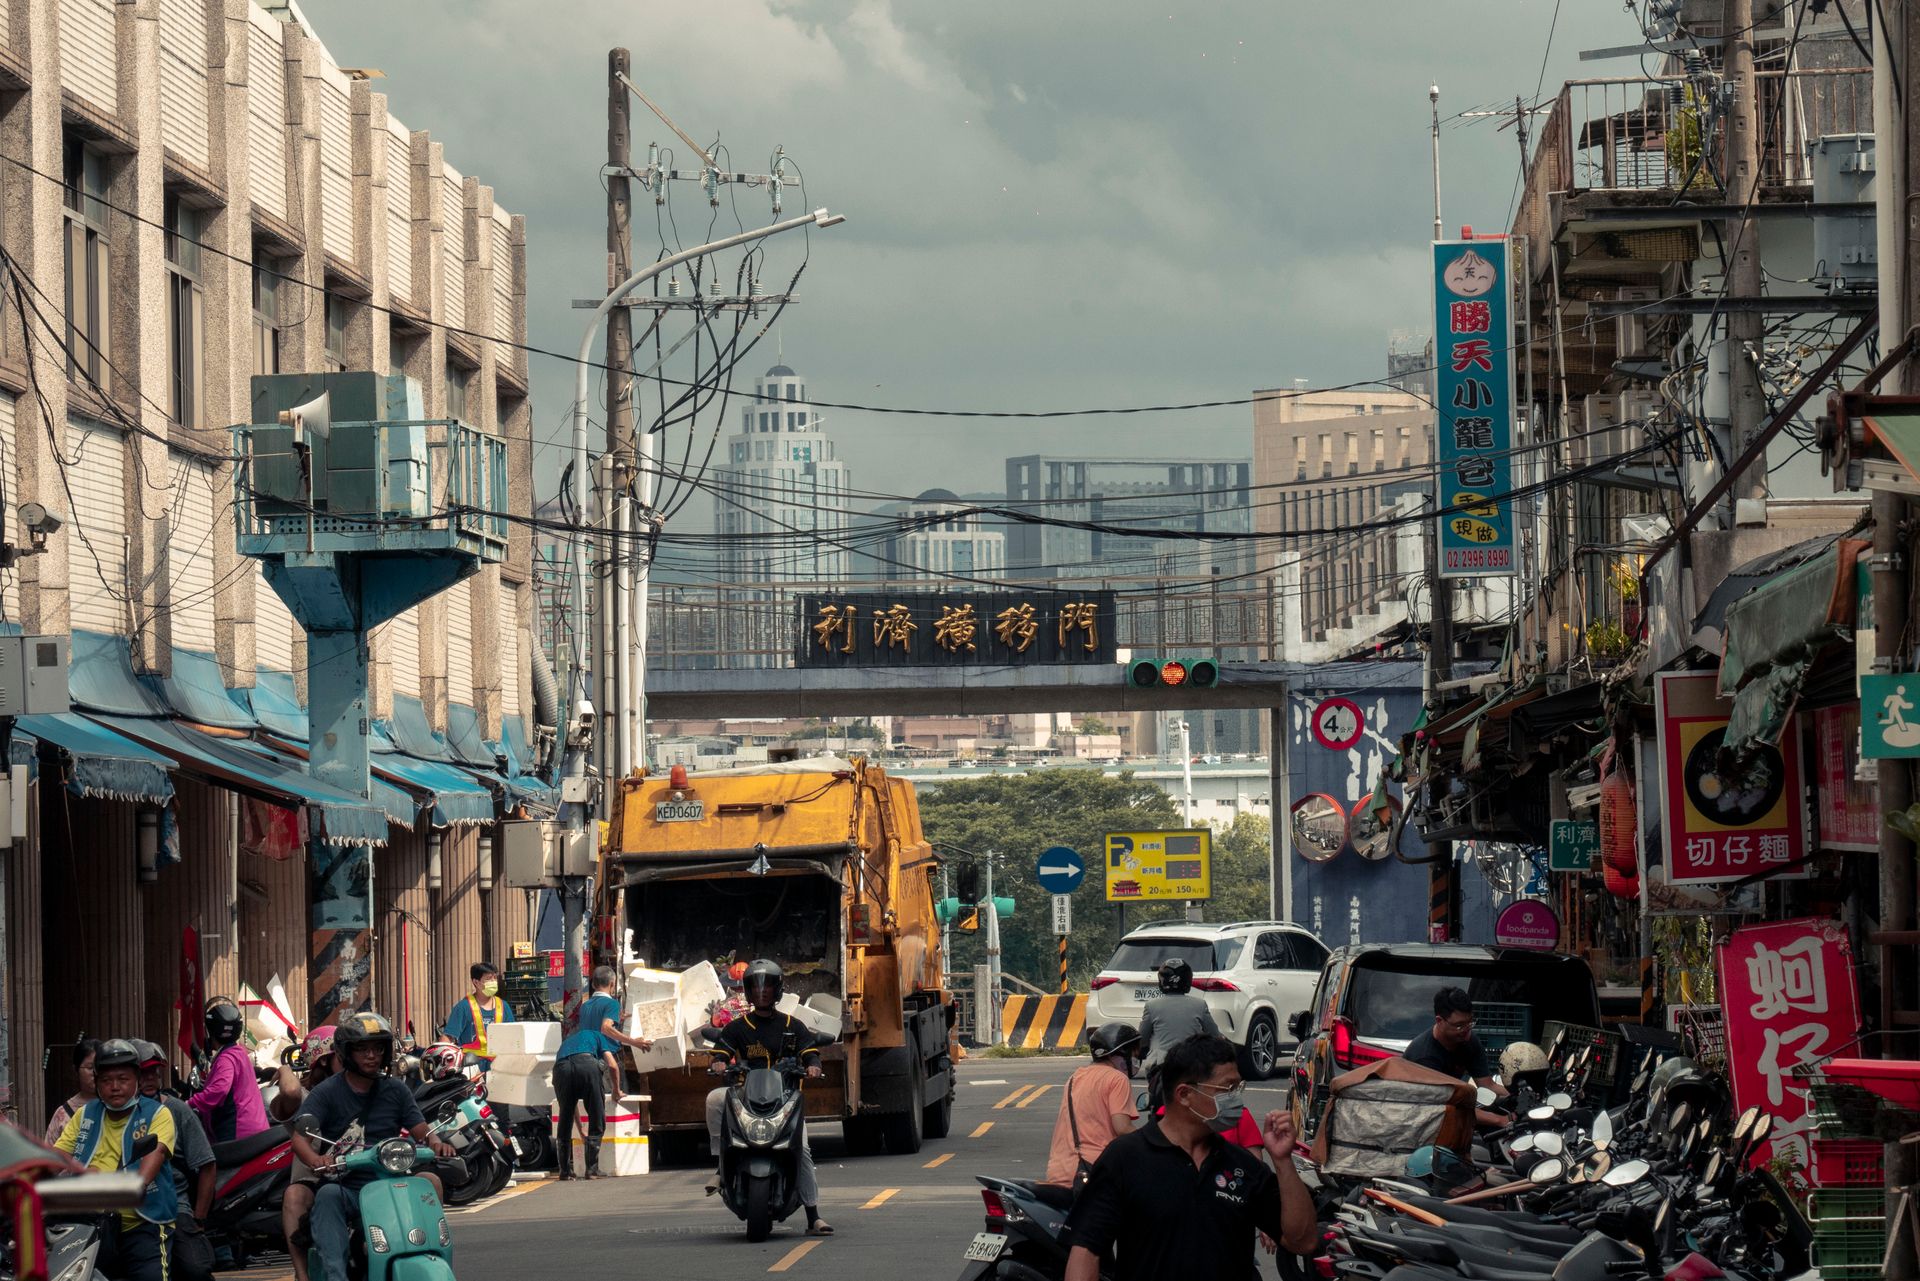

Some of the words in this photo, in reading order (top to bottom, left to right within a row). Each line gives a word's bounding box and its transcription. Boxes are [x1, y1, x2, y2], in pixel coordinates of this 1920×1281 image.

[1449, 300, 1496, 488] 勝天小籠包
[1456, 519, 1493, 542] 現做
[813, 602, 1099, 654] 利濟橫移門
[1111, 836, 1134, 867] P
[1685, 834, 1791, 867] 切仔麵
[1506, 924, 1549, 935] foodpanda
